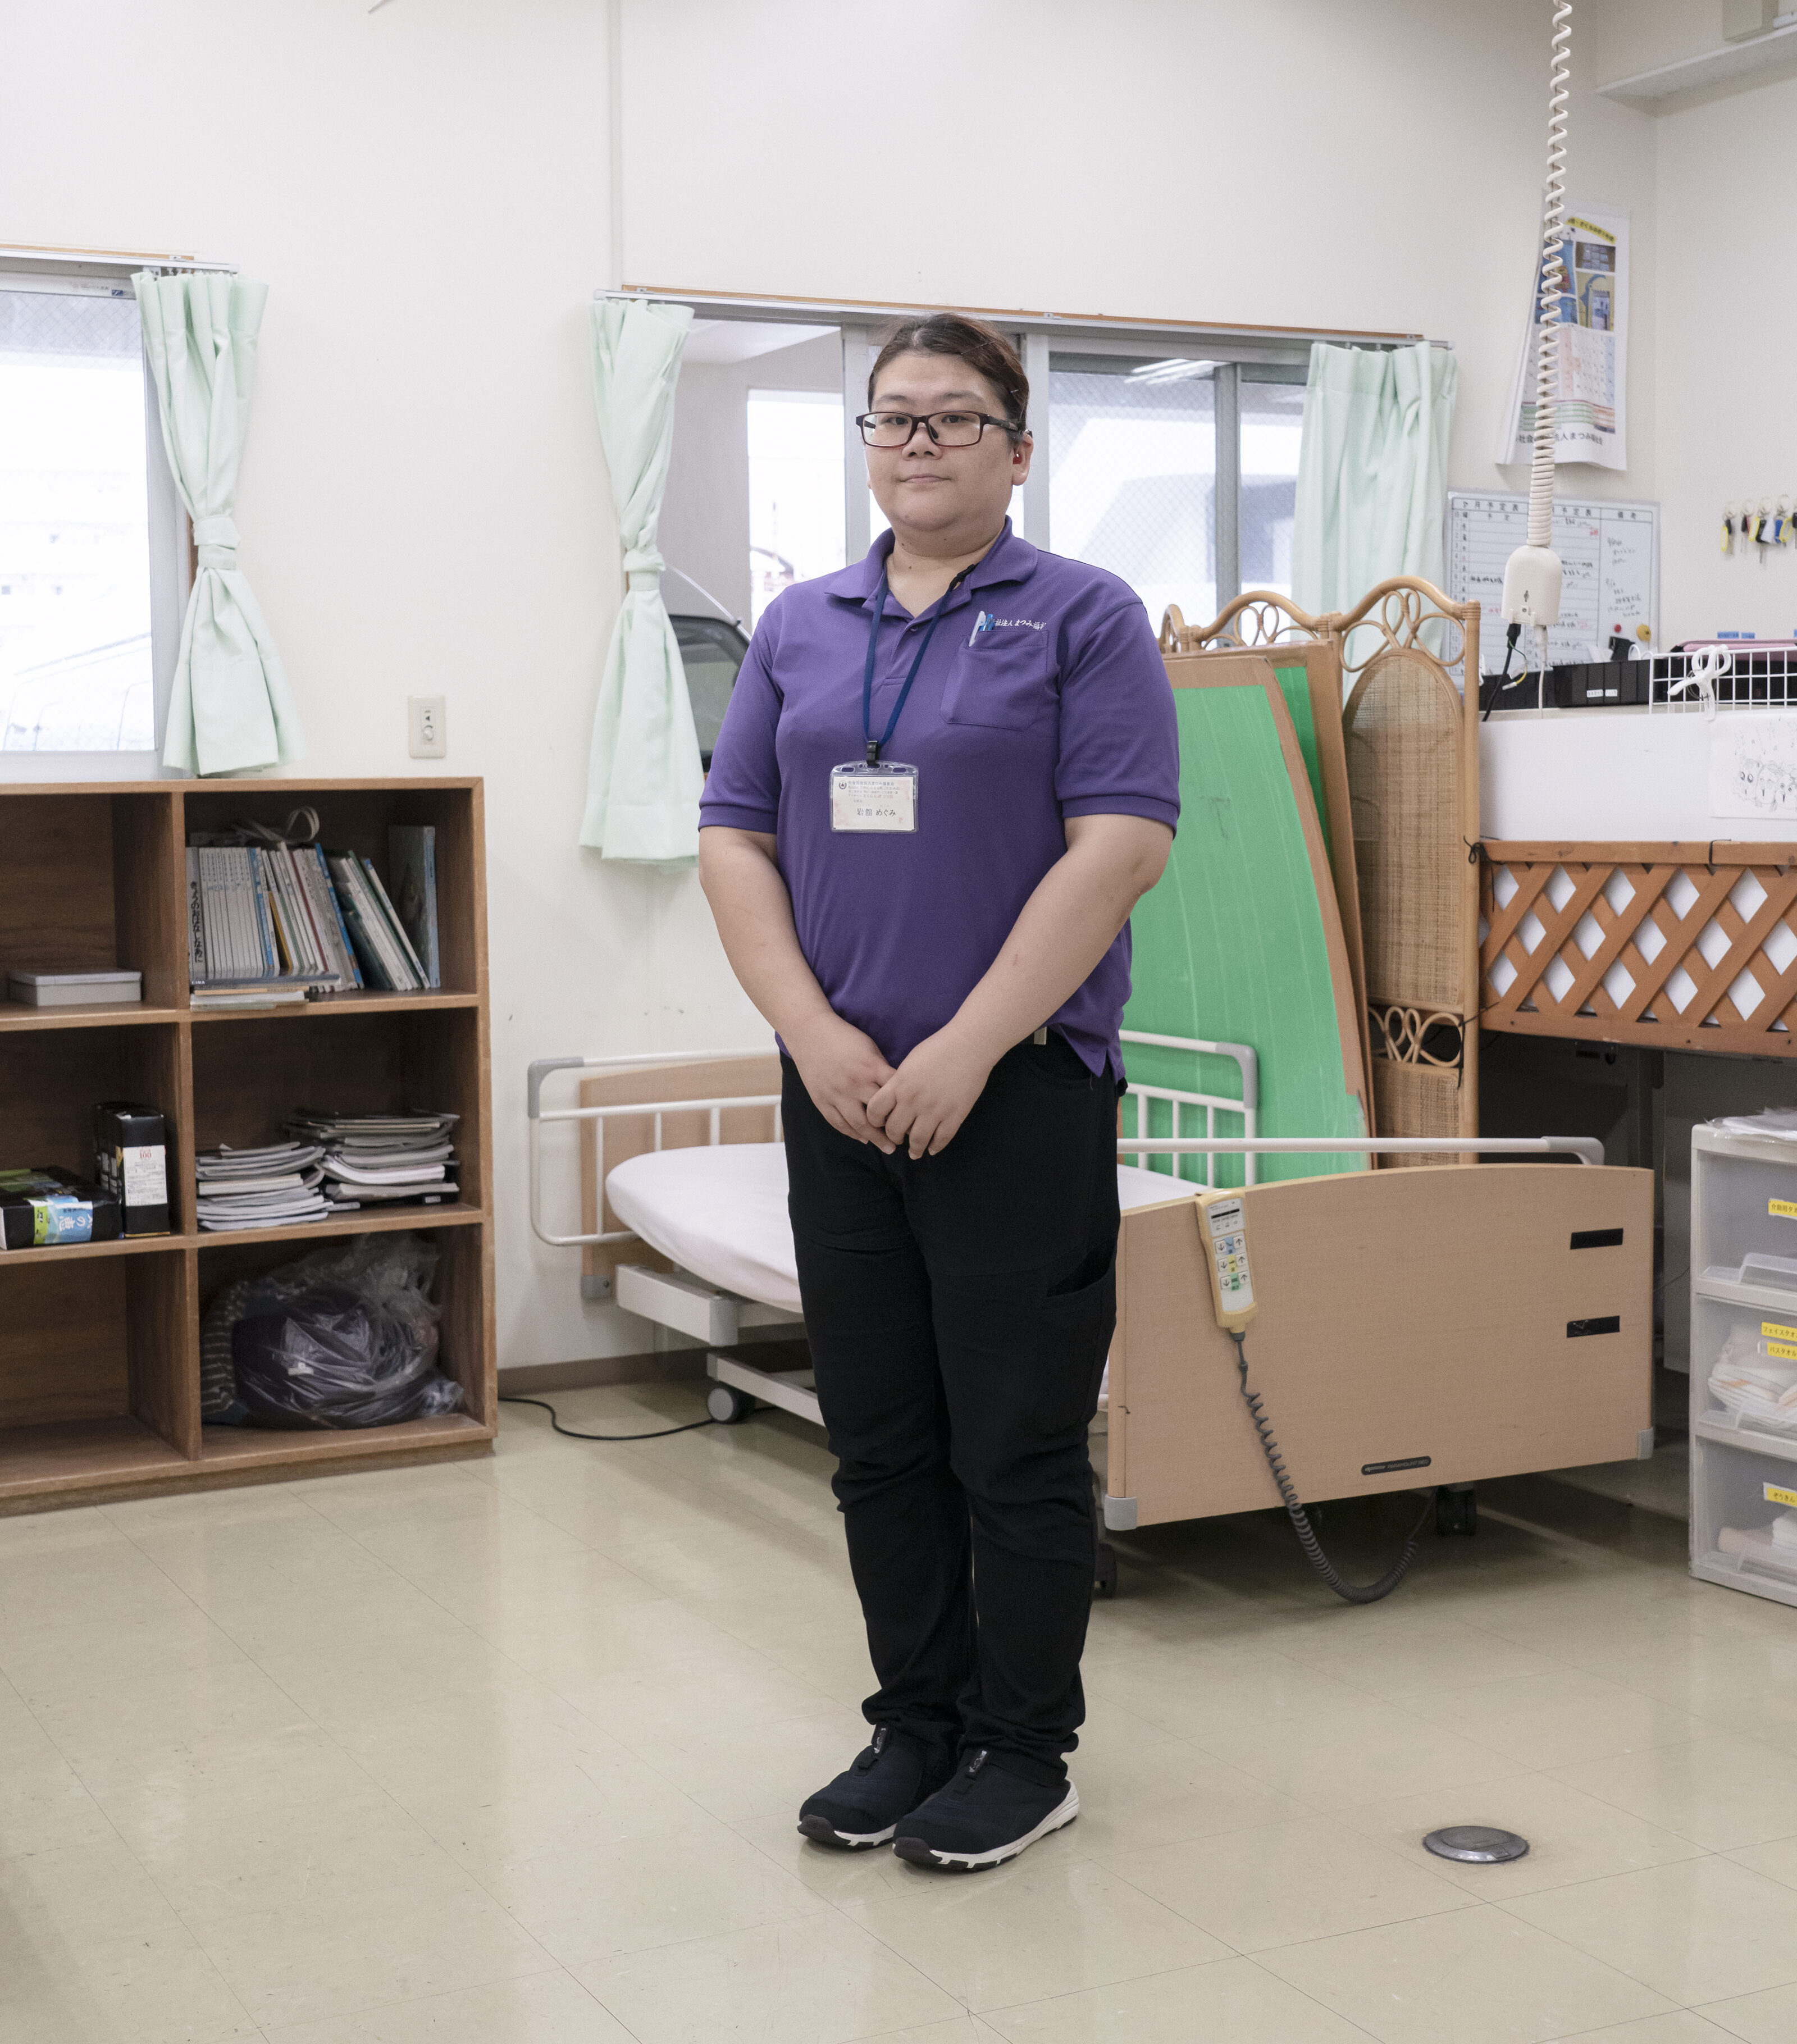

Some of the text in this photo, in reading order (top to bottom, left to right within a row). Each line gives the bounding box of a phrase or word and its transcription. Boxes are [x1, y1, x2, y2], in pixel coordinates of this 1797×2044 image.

[1763, 1326, 1797, 1338] フェイスタオ
